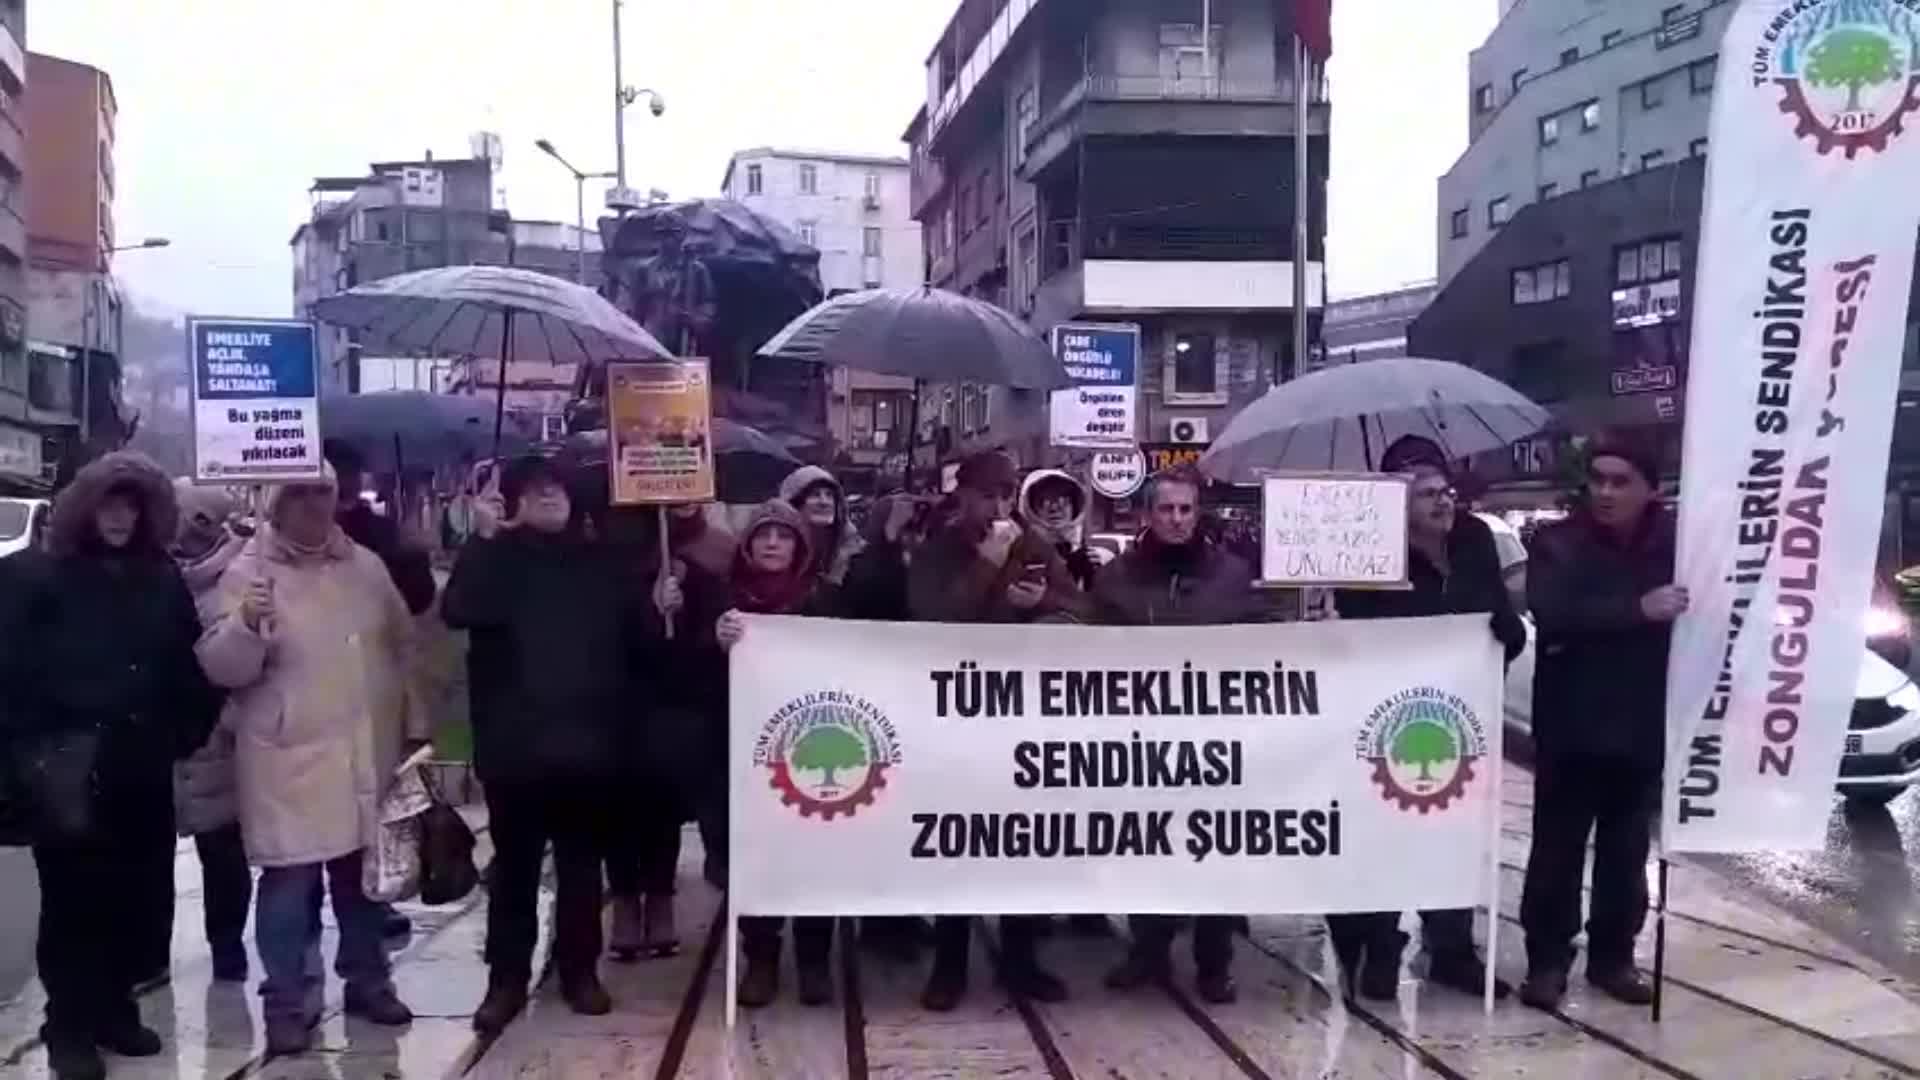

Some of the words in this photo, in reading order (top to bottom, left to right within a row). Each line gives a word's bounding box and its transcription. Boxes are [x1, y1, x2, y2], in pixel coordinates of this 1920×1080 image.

[1832, 114, 1875, 130] 2017
[207, 331, 272, 346] EMEKLİYE
[207, 363, 271, 377] YANDAŞA
[208, 378, 277, 392] SALTANAT!
[228, 408, 248, 423] Bu
[253, 408, 302, 422] yağma
[255, 425, 304, 441] düzeni
[241, 444, 306, 462] yıkılacak
[1679, 735, 1721, 824] TÜM
[1753, 208, 1811, 435] SENDİKASI
[1759, 455, 1830, 776] ZONGULDAK
[930, 660, 1024, 717] TÜM
[1039, 660, 1320, 717] EMEKLİLERİN
[1013, 730, 1243, 788] SENDİKASI
[910, 811, 1174, 858] ZONGULDAK
[1186, 800, 1341, 862] ŞUBESİ
